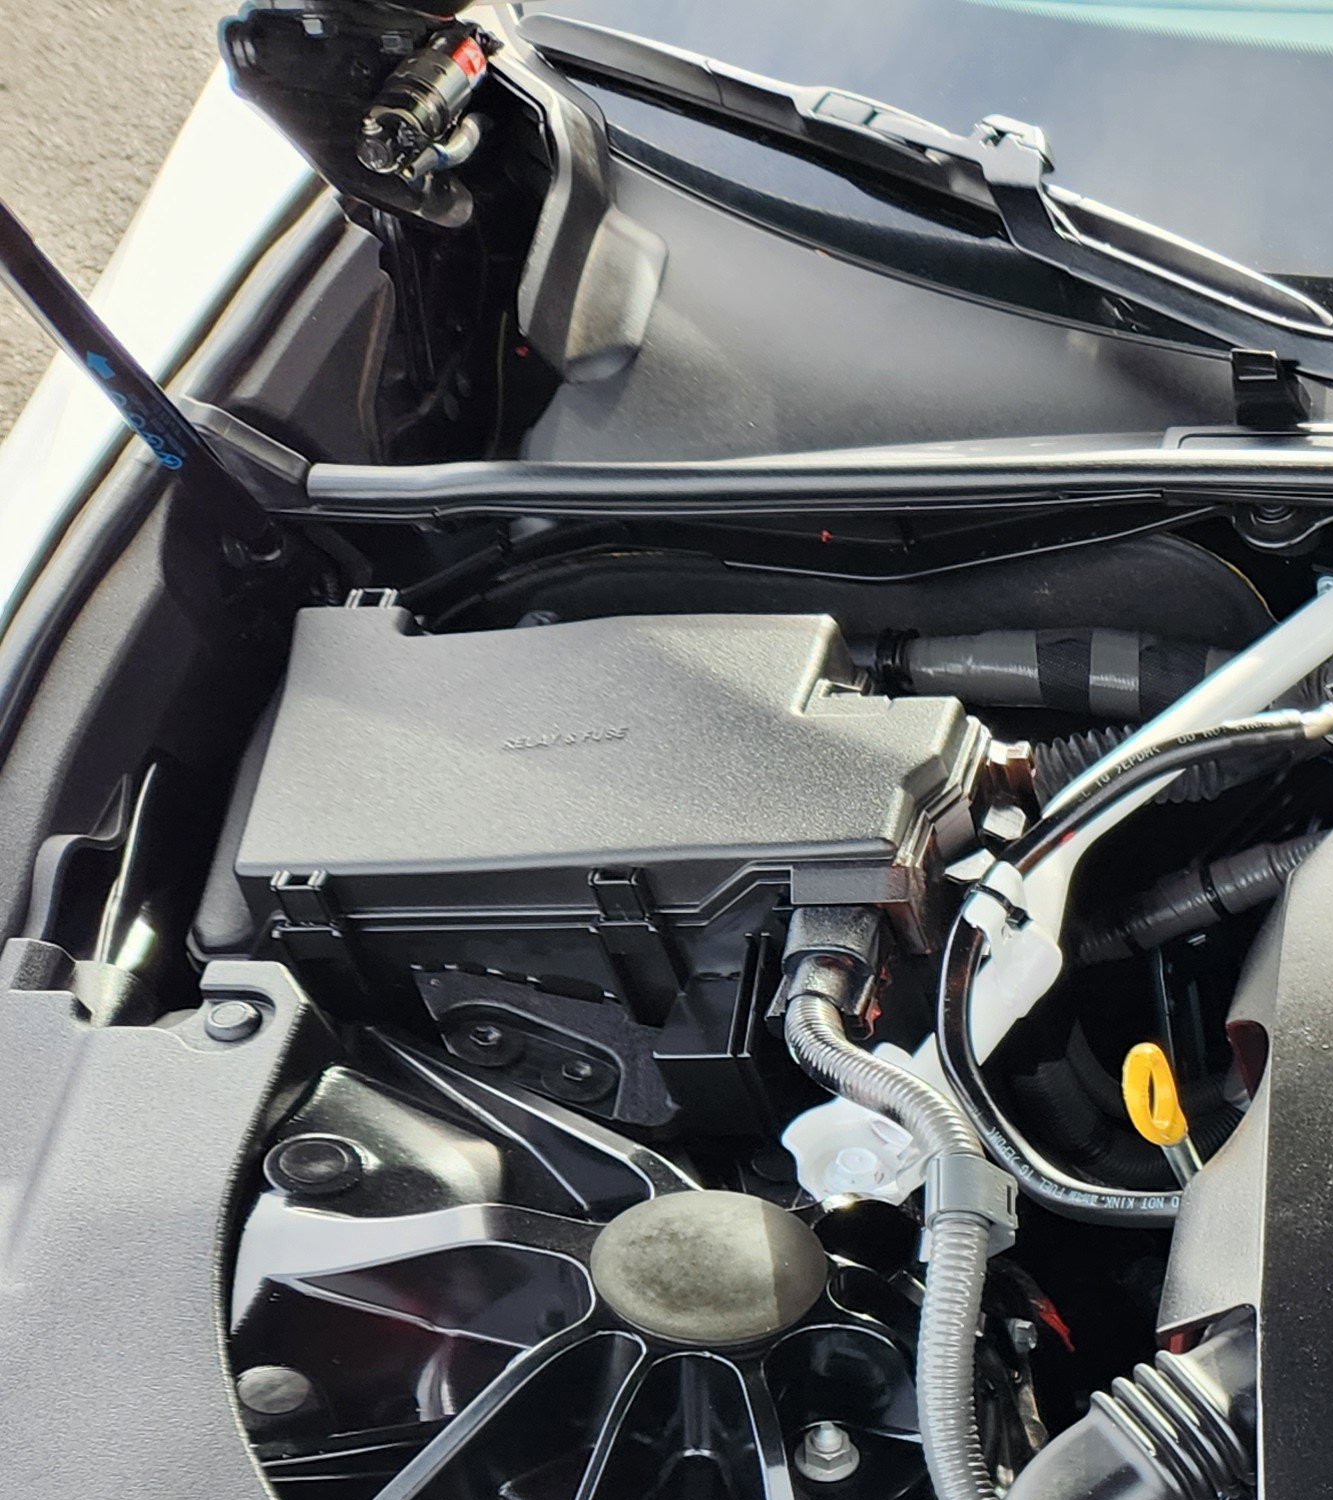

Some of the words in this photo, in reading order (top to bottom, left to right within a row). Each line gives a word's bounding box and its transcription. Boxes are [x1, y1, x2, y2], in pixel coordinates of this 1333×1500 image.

[503, 731, 561, 750] RELAY
[582, 727, 629, 742] FUSE
[1040, 1176, 1066, 1199] FUEL
[1141, 1197, 1164, 1209] NOT
